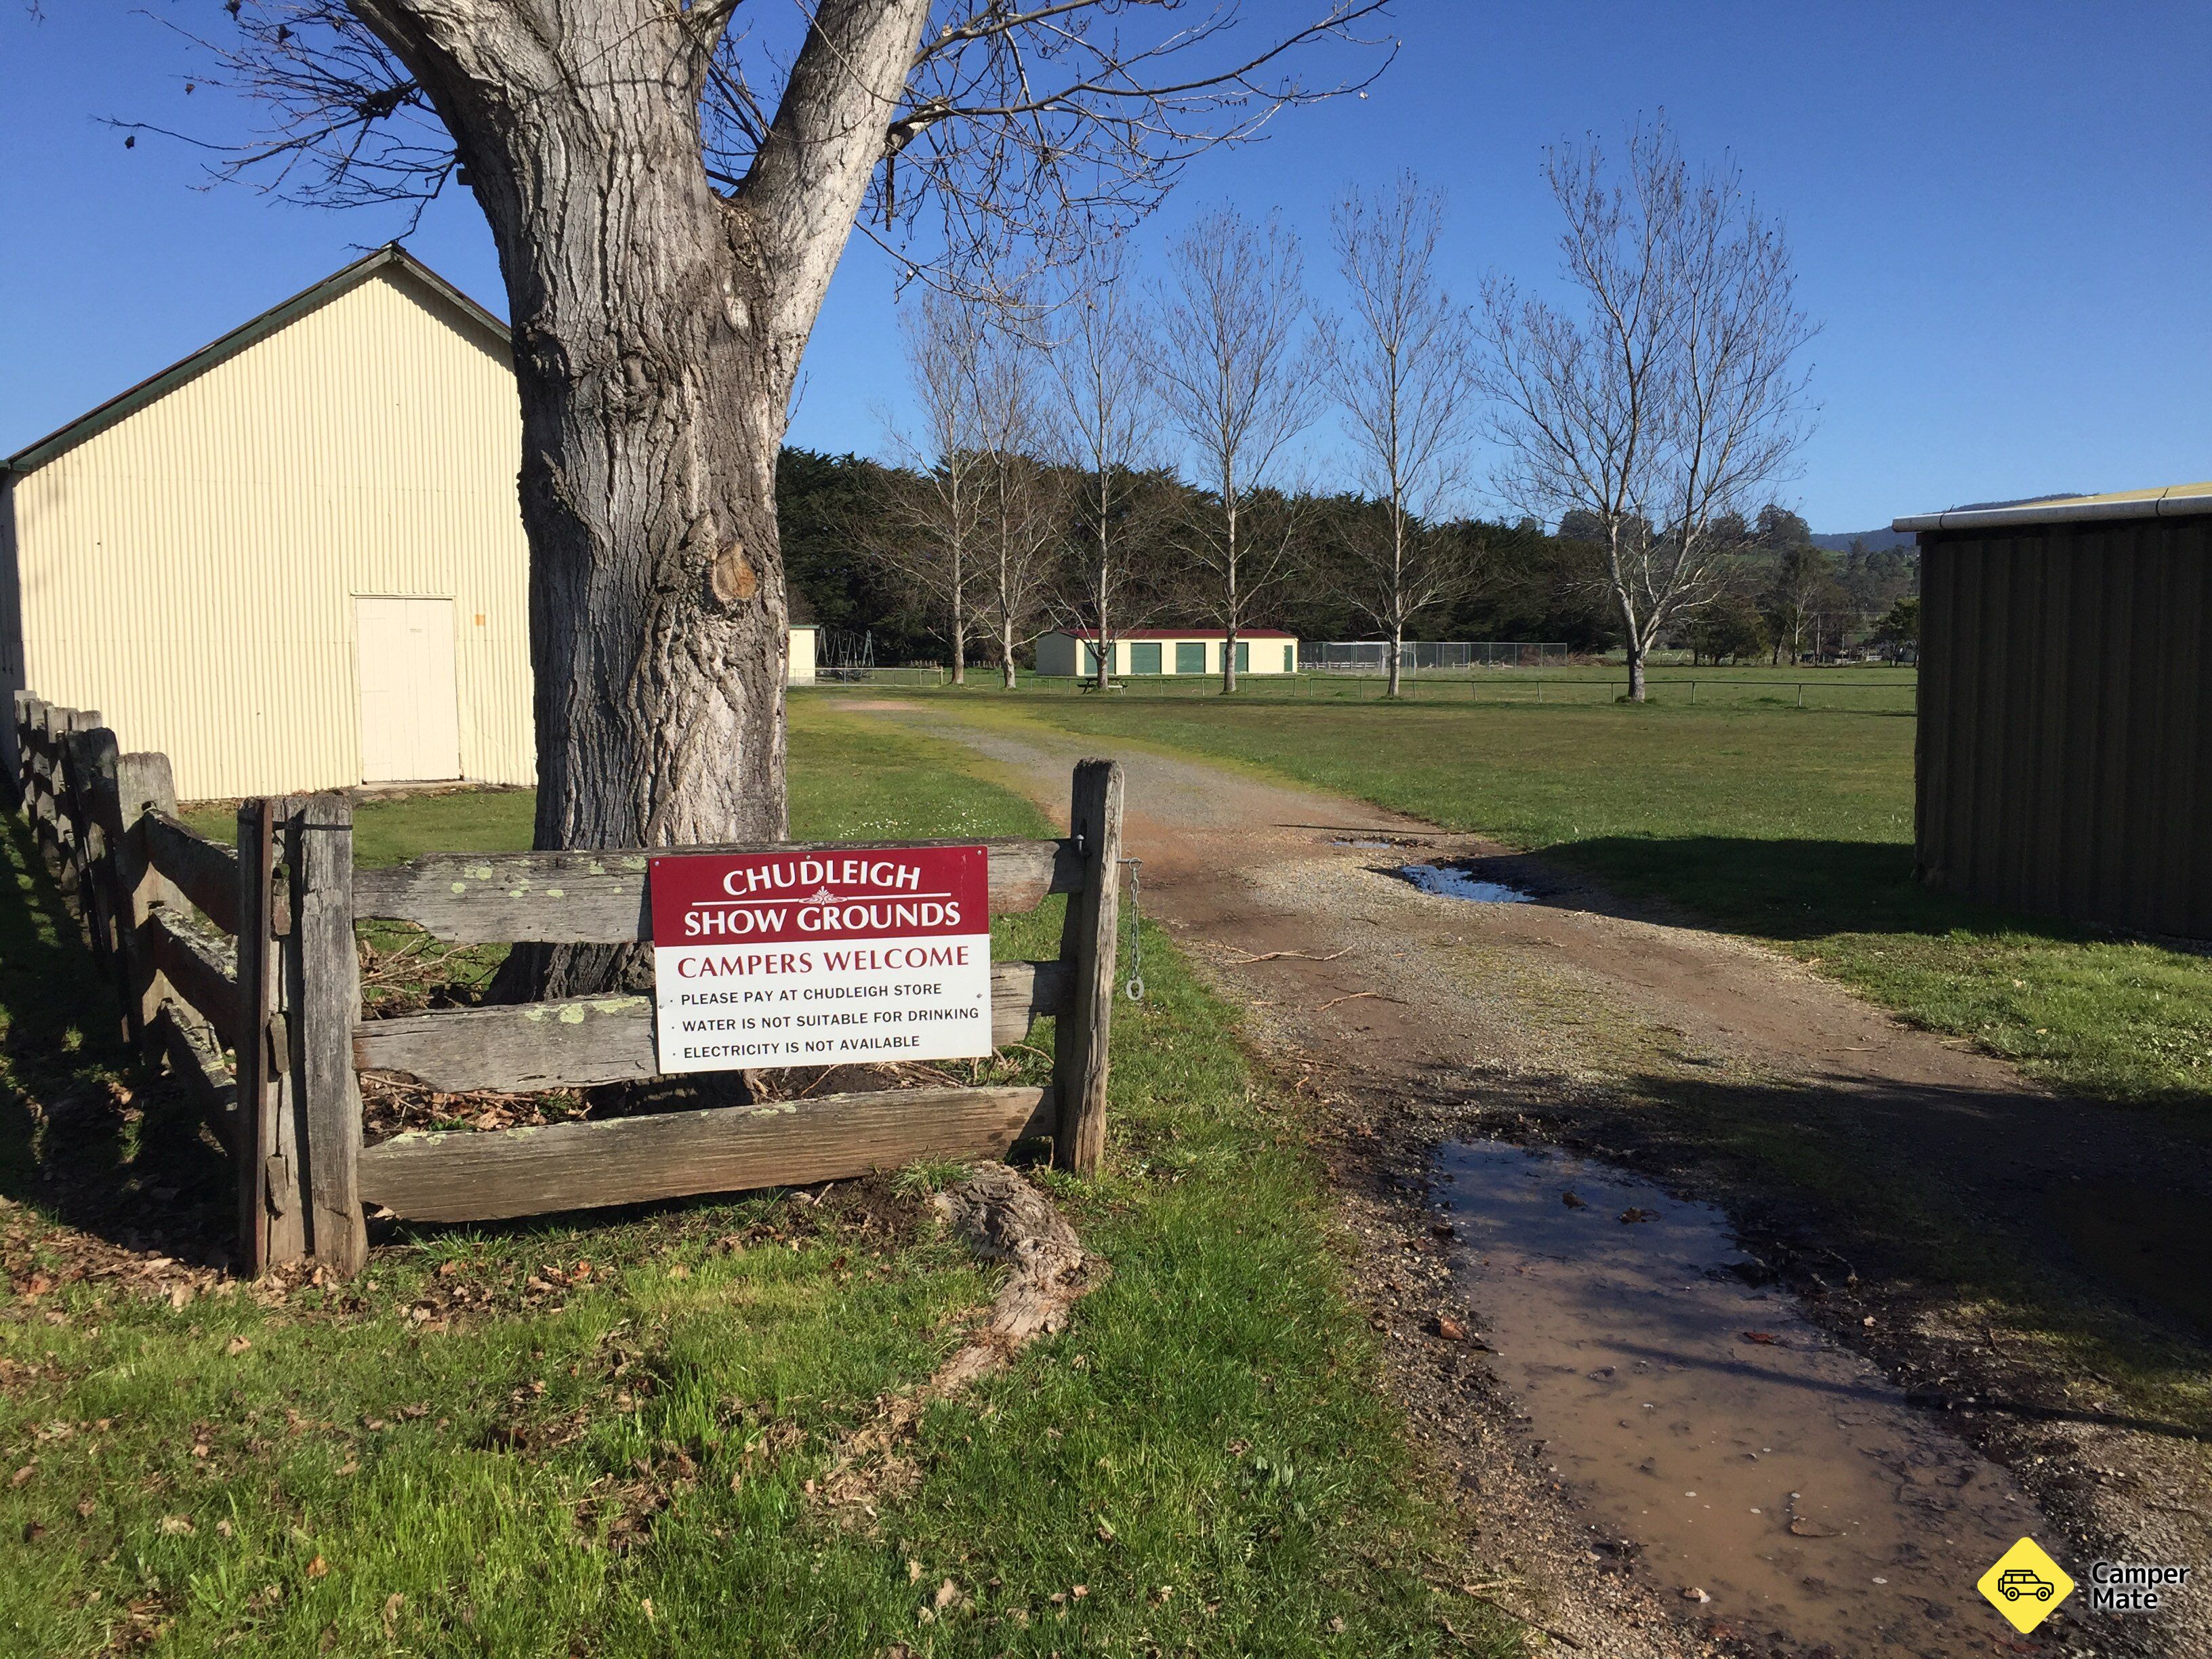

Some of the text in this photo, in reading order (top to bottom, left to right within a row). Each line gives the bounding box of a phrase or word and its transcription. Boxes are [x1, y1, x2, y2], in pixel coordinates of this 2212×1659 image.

[723, 860, 921, 896] CHUDLEIGH
[684, 901, 961, 936] SHOW GROUNDS
[678, 946, 969, 978] CAMPERS WELCOME
[681, 983, 942, 1005] PLEASE PAY AT CHUDLEIGH STORE
[682, 1007, 979, 1032] WATER IS NOT SUITABLE FOR DRINKING
[684, 1036, 920, 1059] ELECTRICITY IS NOT AVAILABLE
